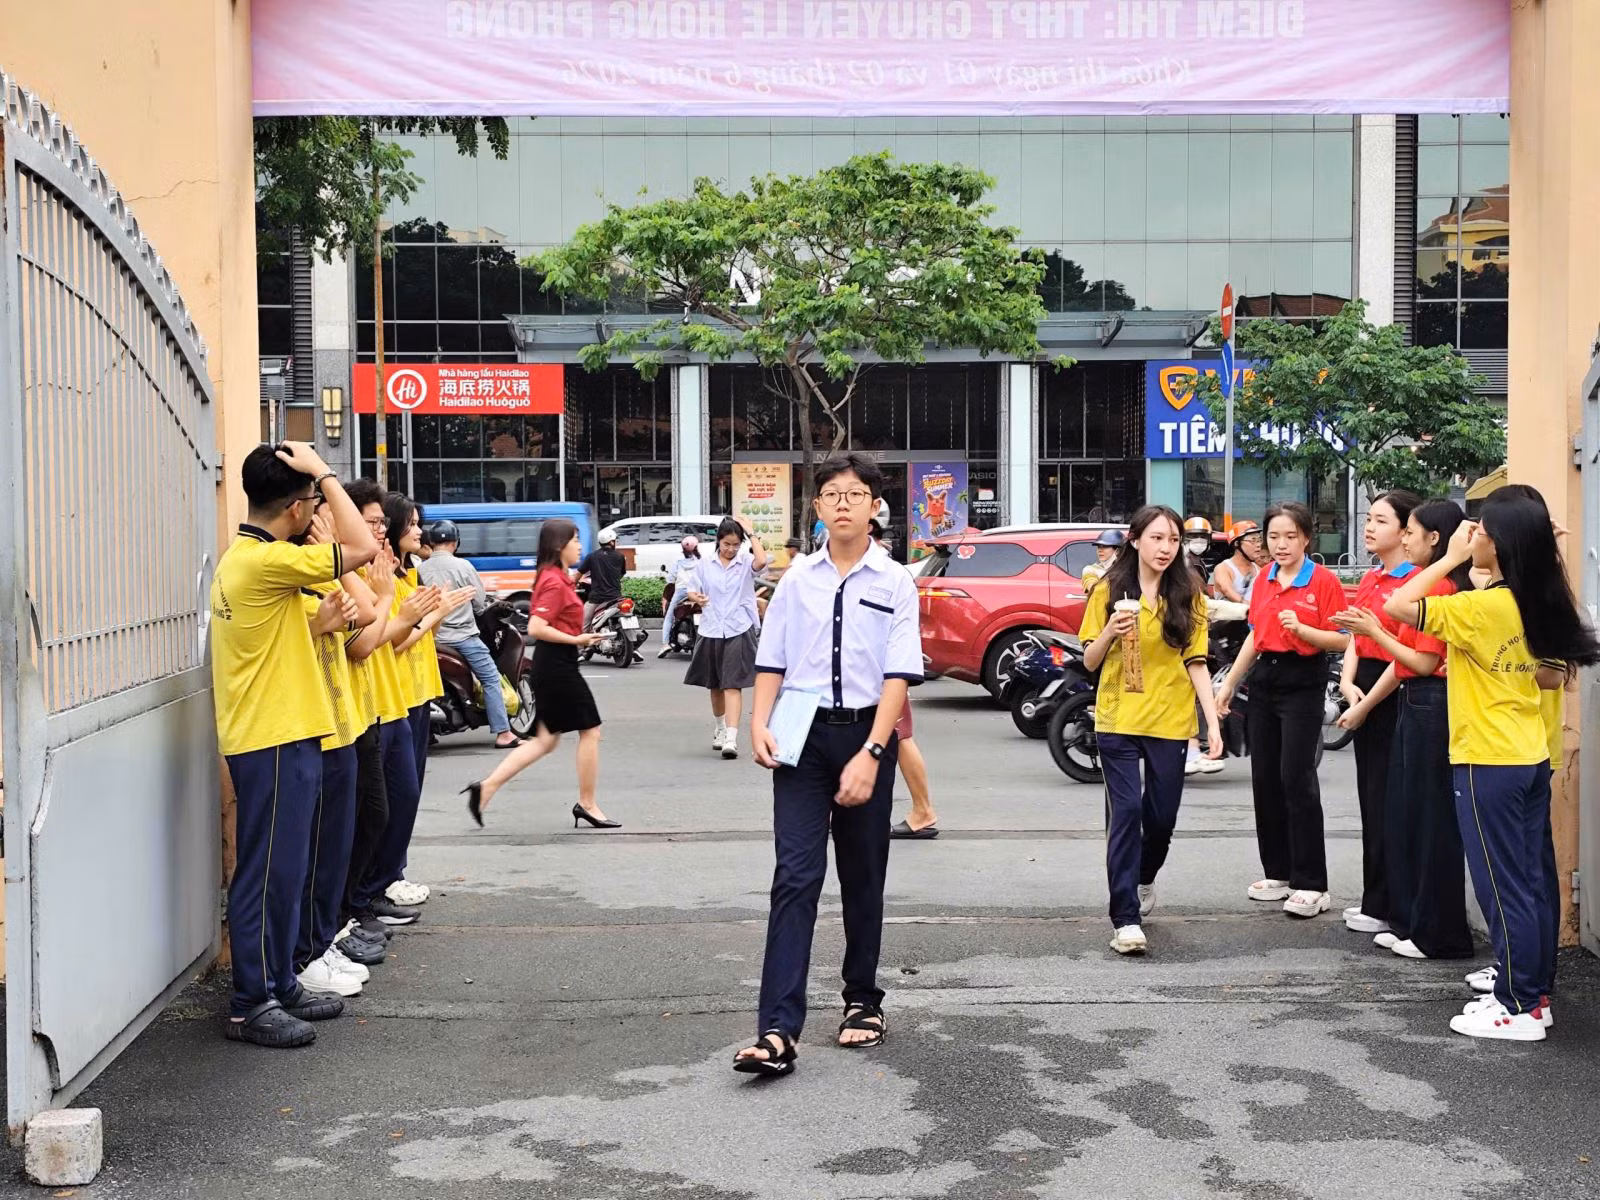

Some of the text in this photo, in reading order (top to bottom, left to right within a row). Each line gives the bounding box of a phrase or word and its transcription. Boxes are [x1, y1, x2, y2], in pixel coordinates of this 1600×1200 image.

[438, 369, 457, 378] Nhà
[457, 369, 480, 379] hàng
[495, 369, 529, 378] Haidilao
[395, 378, 418, 401] Hi
[439, 379, 531, 397] 海底捞火锅
[439, 397, 484, 407] Haidilao
[968, 471, 997, 480] ASIO
[741, 503, 770, 516] 400
[1490, 644, 1508, 673] TRUNG
